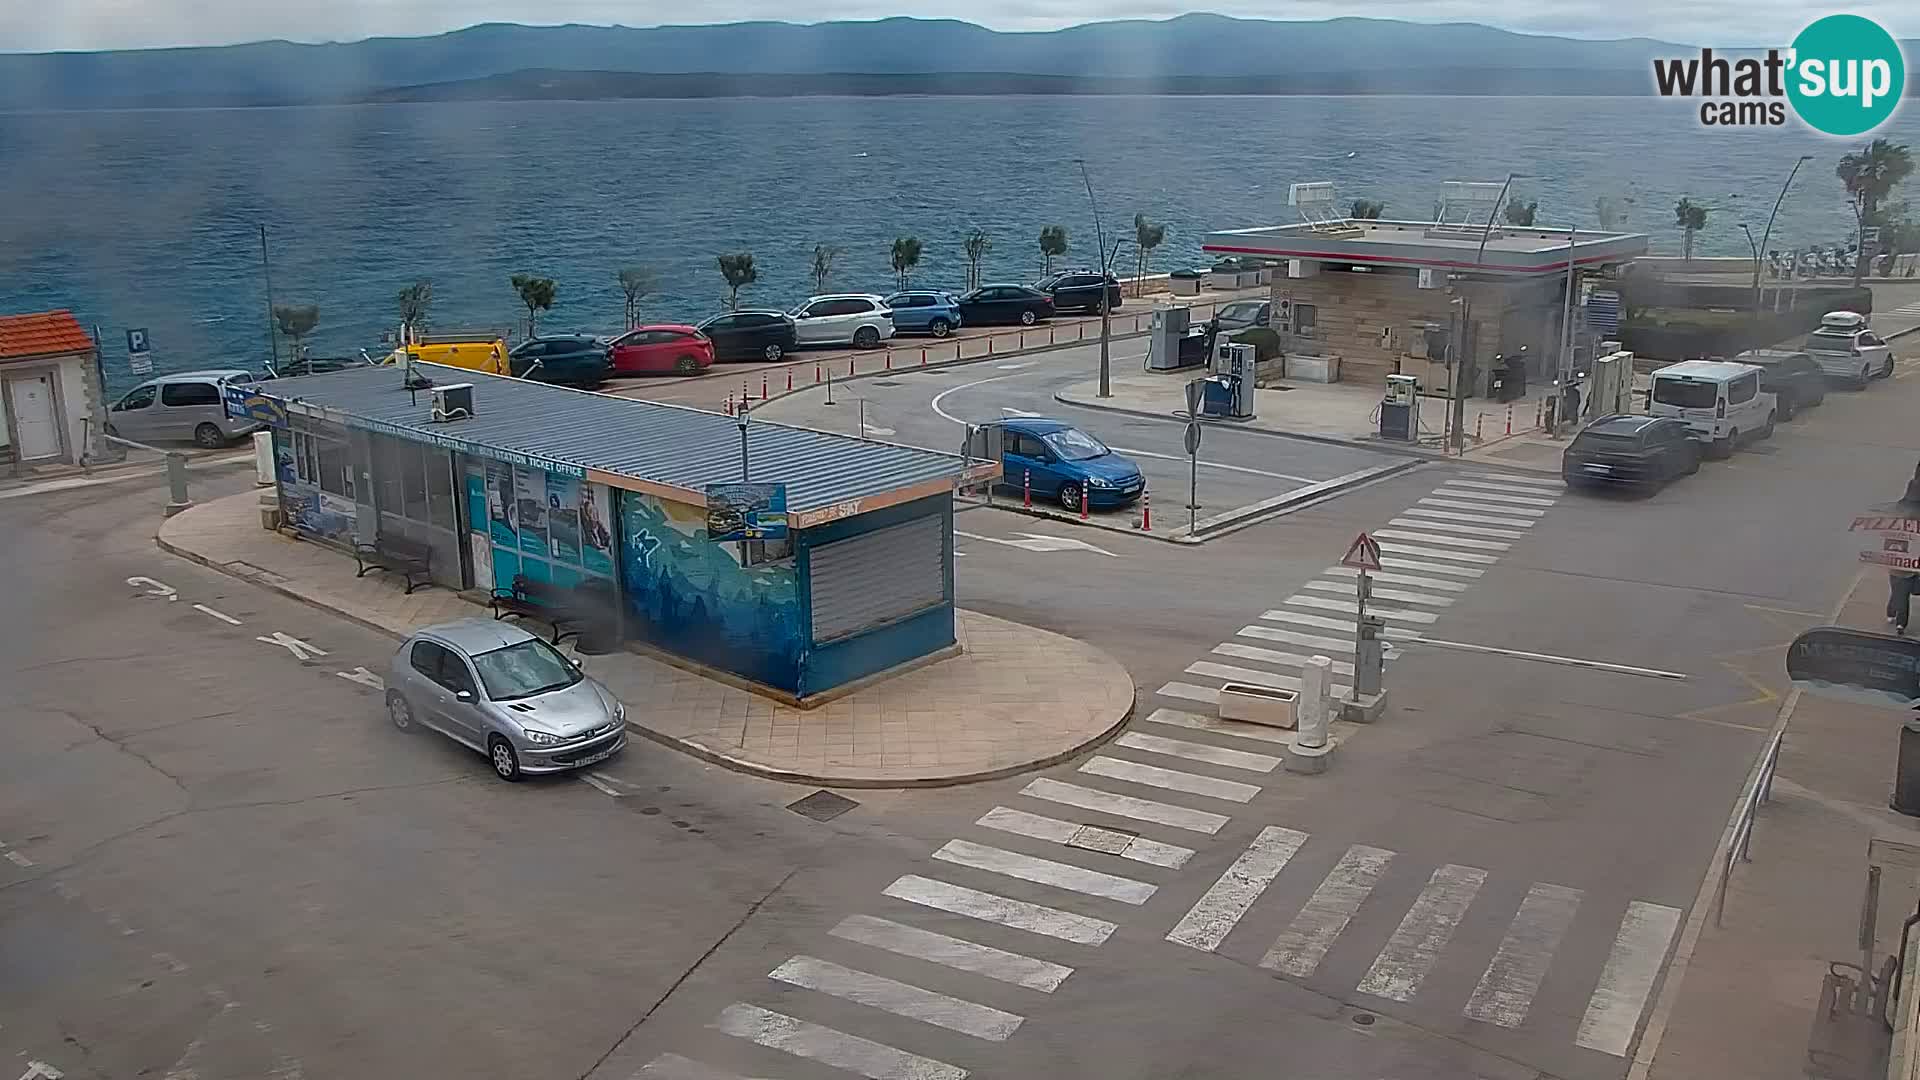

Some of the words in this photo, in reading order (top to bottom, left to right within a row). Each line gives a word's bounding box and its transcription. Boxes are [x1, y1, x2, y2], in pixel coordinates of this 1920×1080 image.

[131, 331, 144, 350] P
[479, 445, 493, 458] BUS
[495, 449, 527, 465] STATION
[529, 457, 555, 471] TICKET
[555, 463, 583, 477] OFFICE
